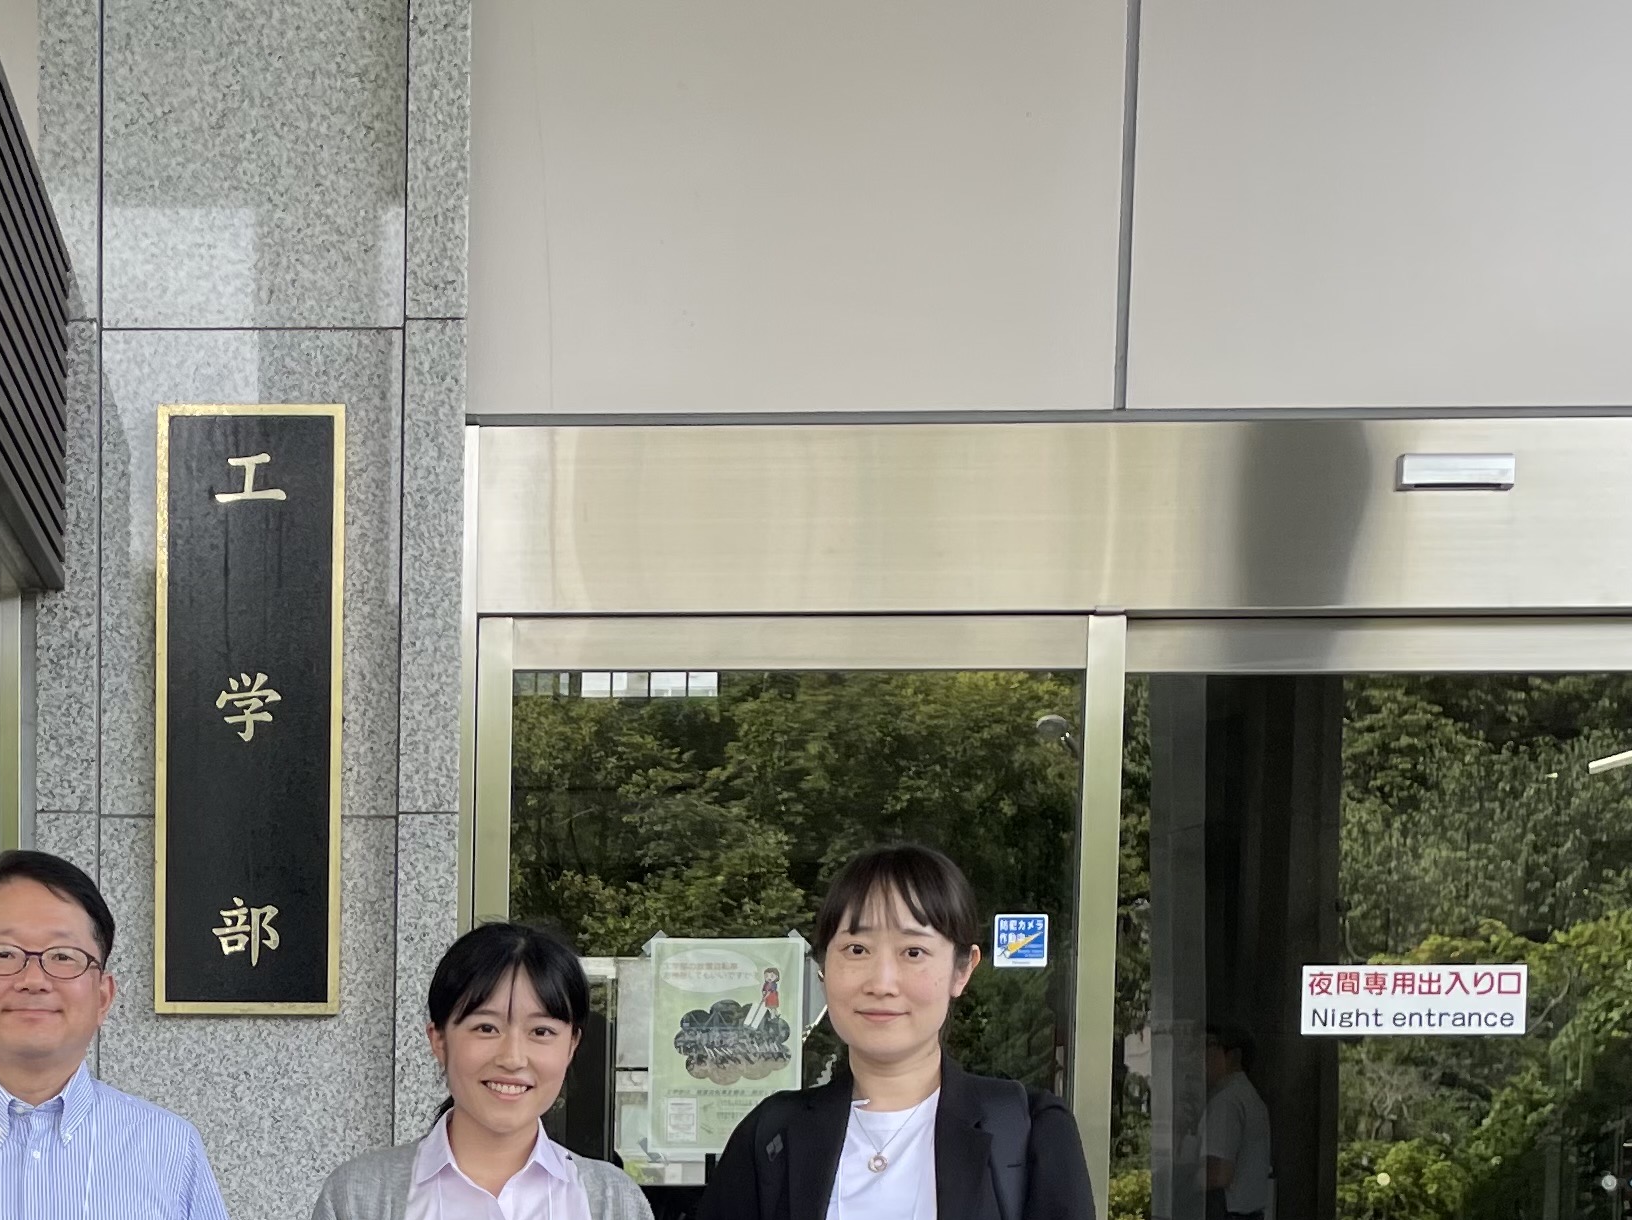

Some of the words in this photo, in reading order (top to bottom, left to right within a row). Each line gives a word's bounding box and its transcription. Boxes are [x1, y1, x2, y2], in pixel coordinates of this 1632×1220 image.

[211, 452, 287, 968] 工学部
[1308, 971, 1522, 997] 夜間専用出入り口
[1311, 1008, 1384, 1028] Night
[1392, 1008, 1515, 1028] entrance
